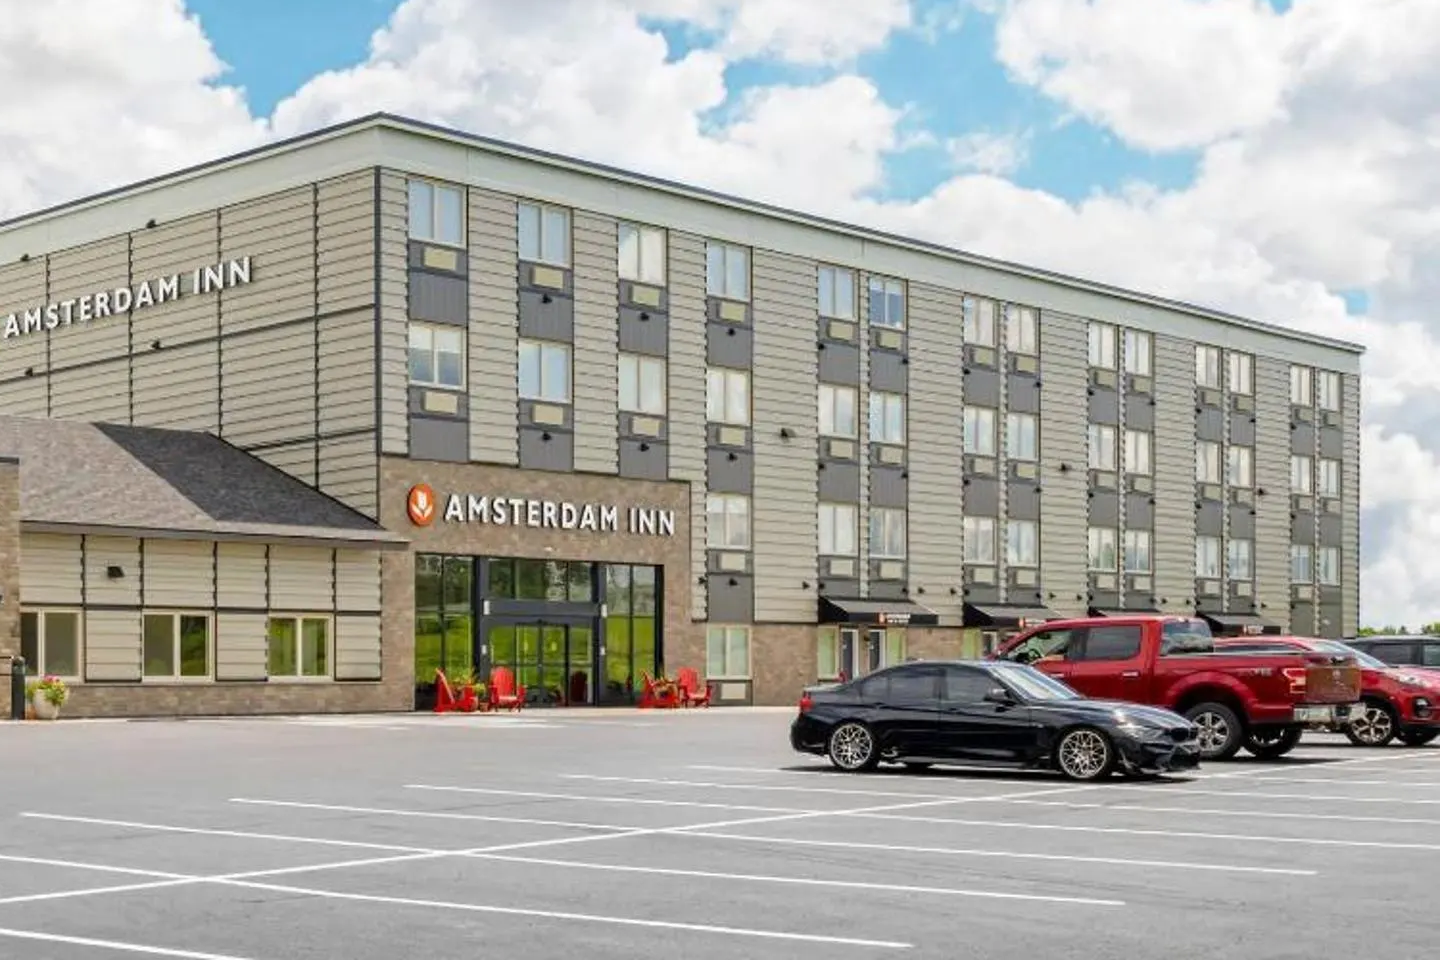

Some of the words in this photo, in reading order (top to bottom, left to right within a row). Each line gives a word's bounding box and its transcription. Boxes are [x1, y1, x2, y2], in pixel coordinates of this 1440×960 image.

[3, 273, 180, 339] AMSTERDAM
[192, 256, 252, 295] INN
[444, 494, 618, 532] AMSTERDAM
[627, 507, 675, 536] INN
